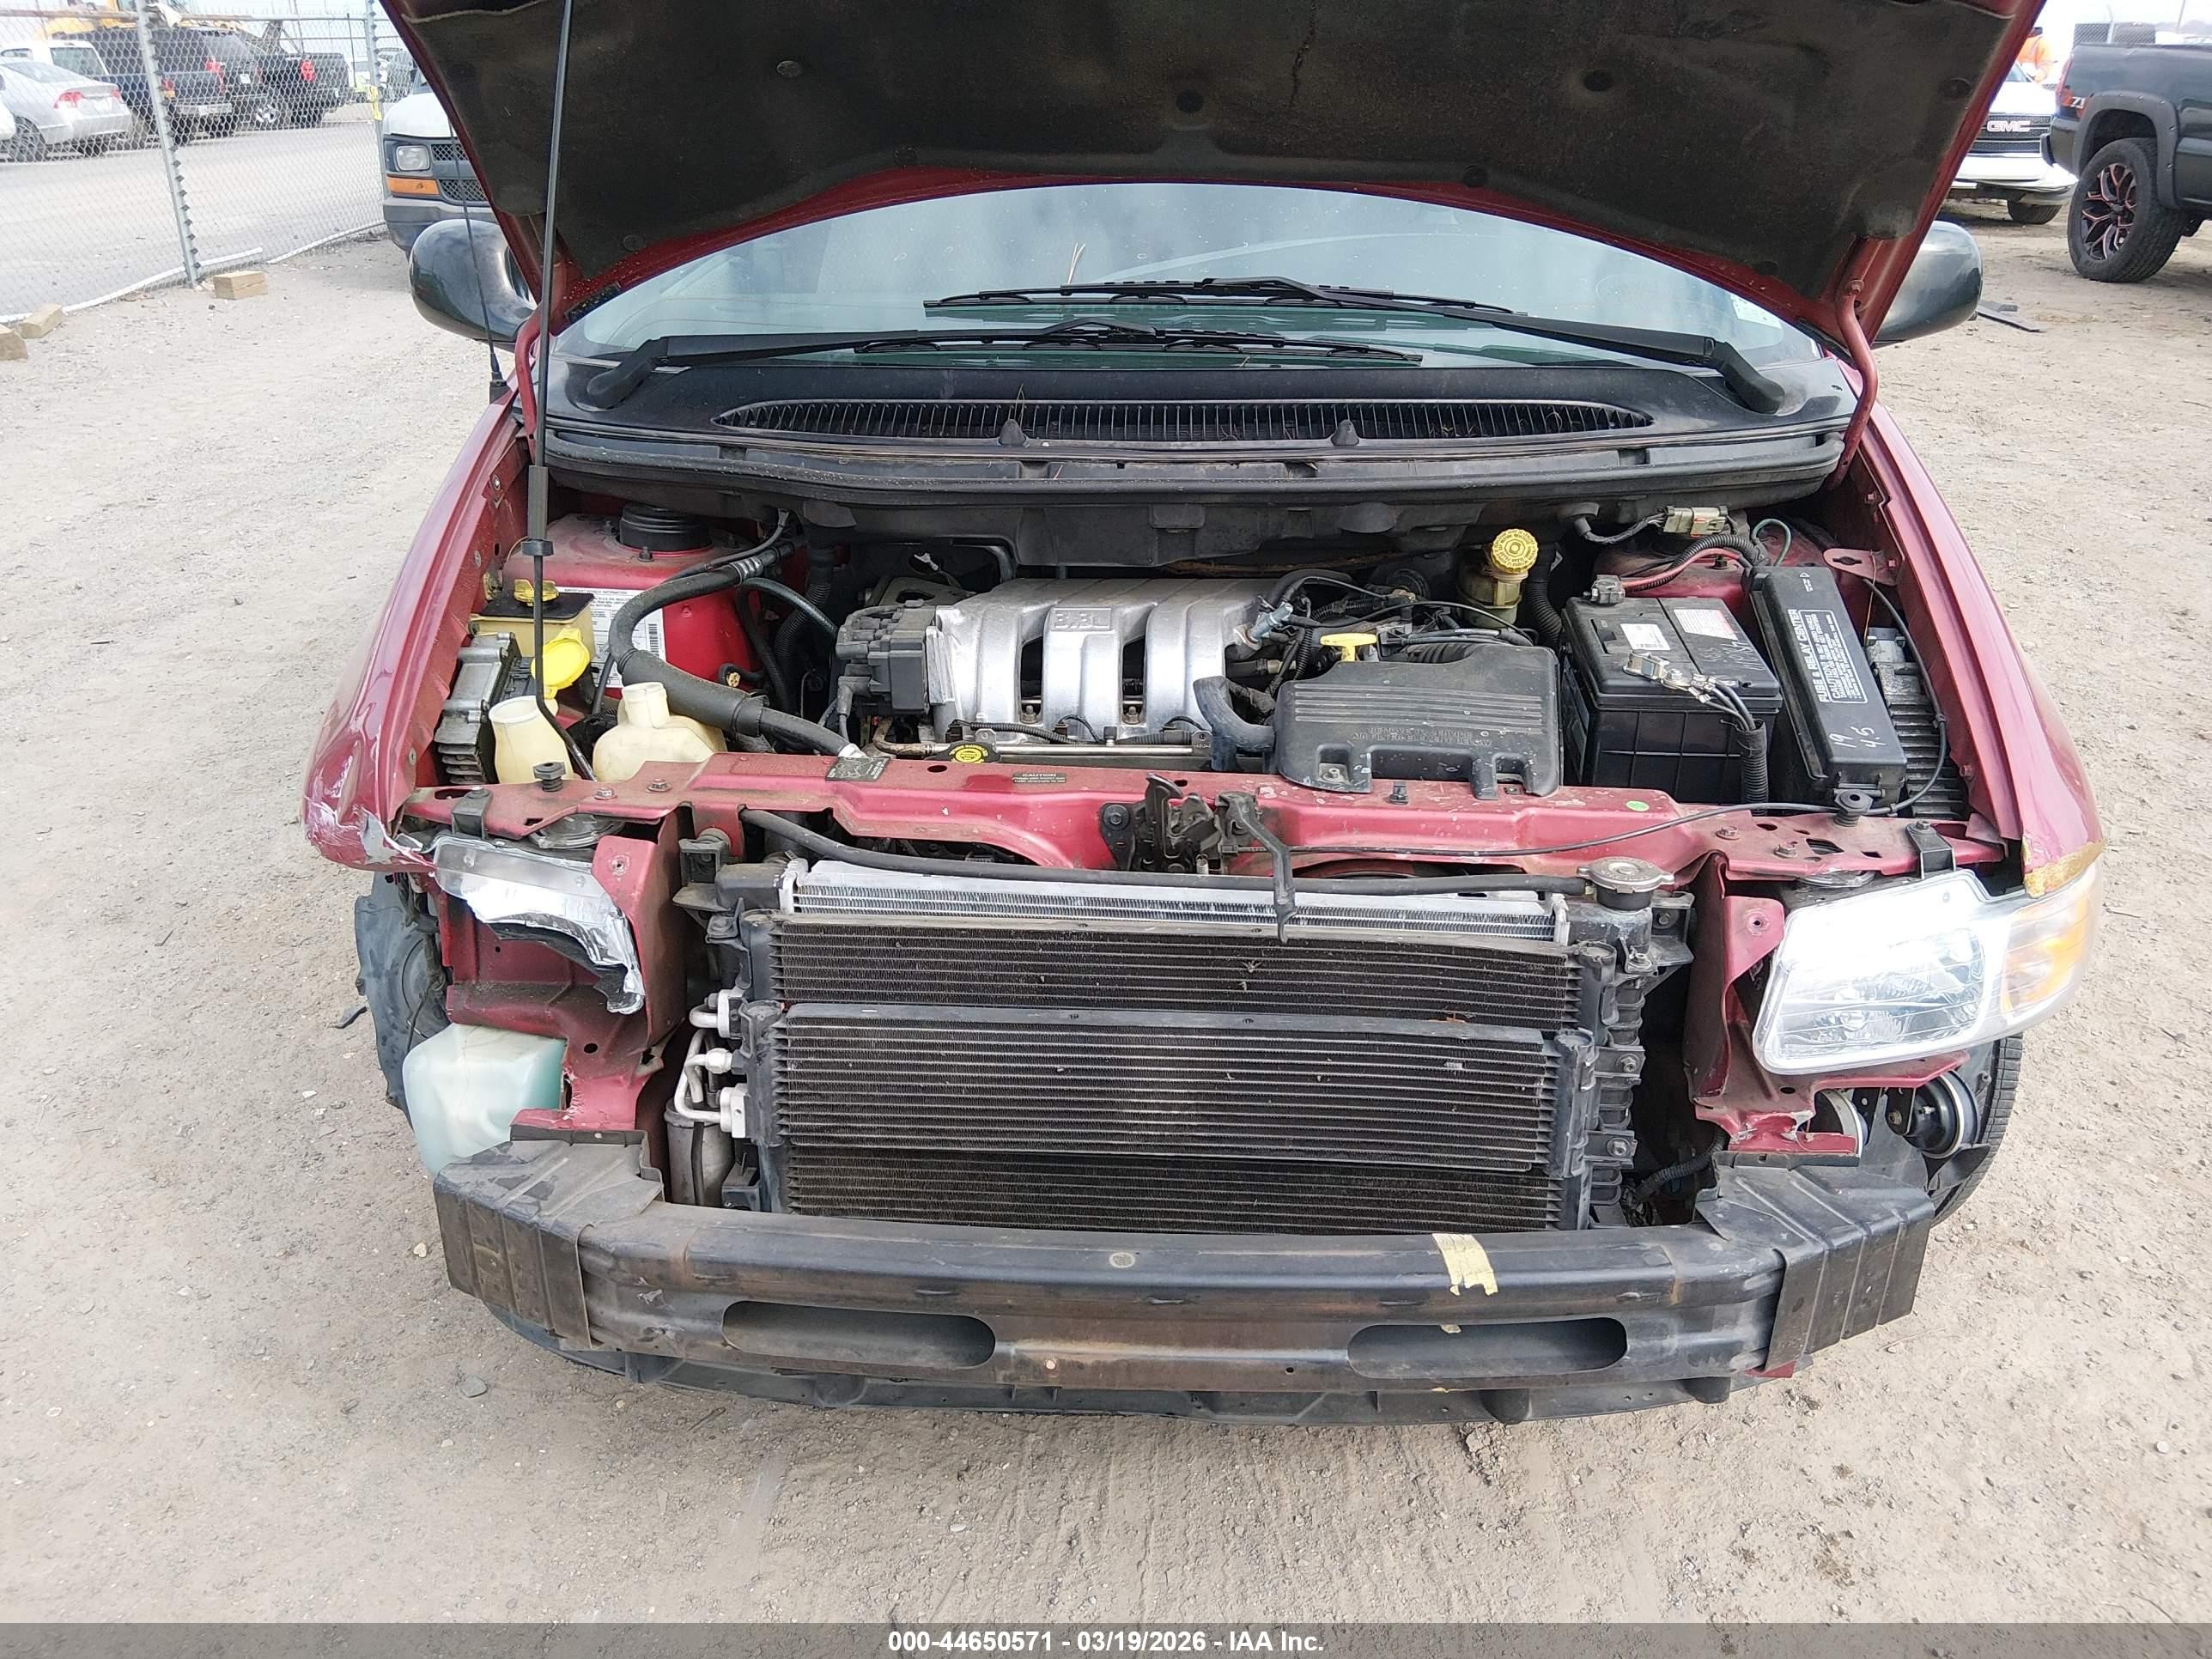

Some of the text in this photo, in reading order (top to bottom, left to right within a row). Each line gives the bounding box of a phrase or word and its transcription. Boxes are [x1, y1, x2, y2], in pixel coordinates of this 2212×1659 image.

[1986, 120, 2031, 132] GMC
[1787, 609, 1807, 641] CENTER
[1799, 643, 1818, 669] RELAY
[1812, 679, 1830, 702] FUSE
[1820, 661, 1840, 698] CAUTION!
